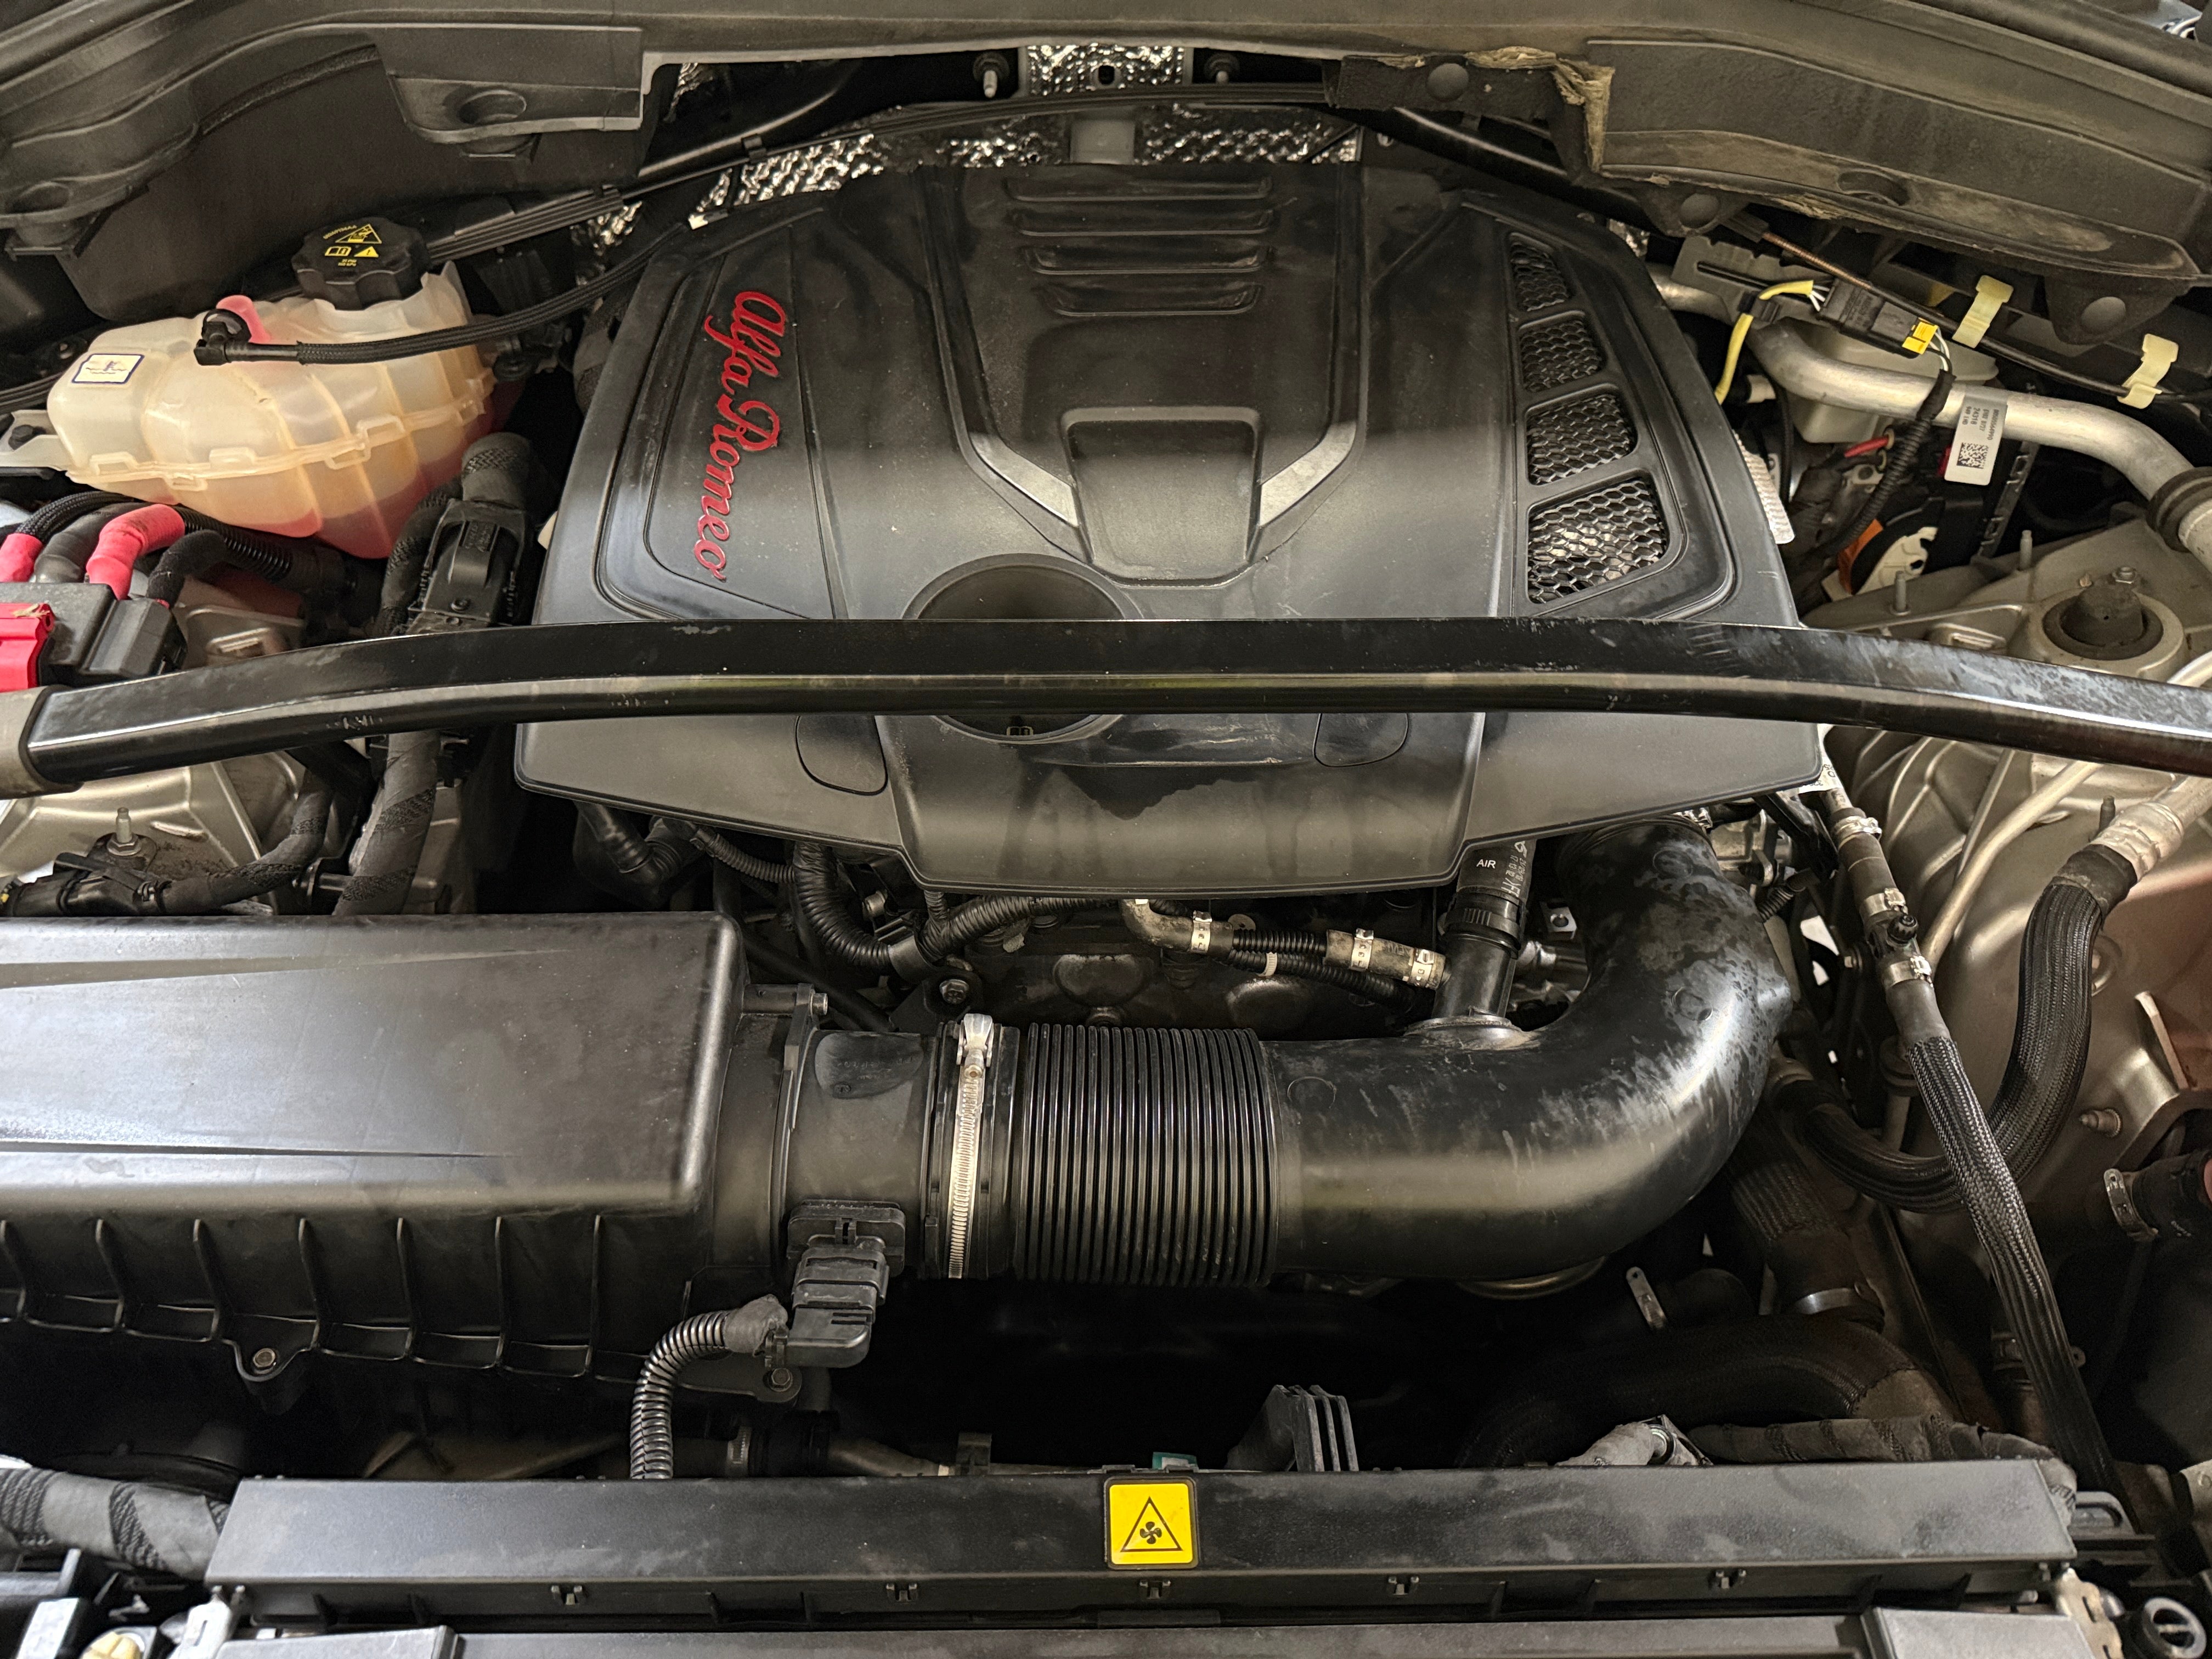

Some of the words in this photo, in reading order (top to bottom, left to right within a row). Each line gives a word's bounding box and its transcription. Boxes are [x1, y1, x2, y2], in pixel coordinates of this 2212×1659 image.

[704, 291, 787, 394] Alfa
[694, 393, 780, 582] Romeo
[1476, 859, 1496, 868] AIR
